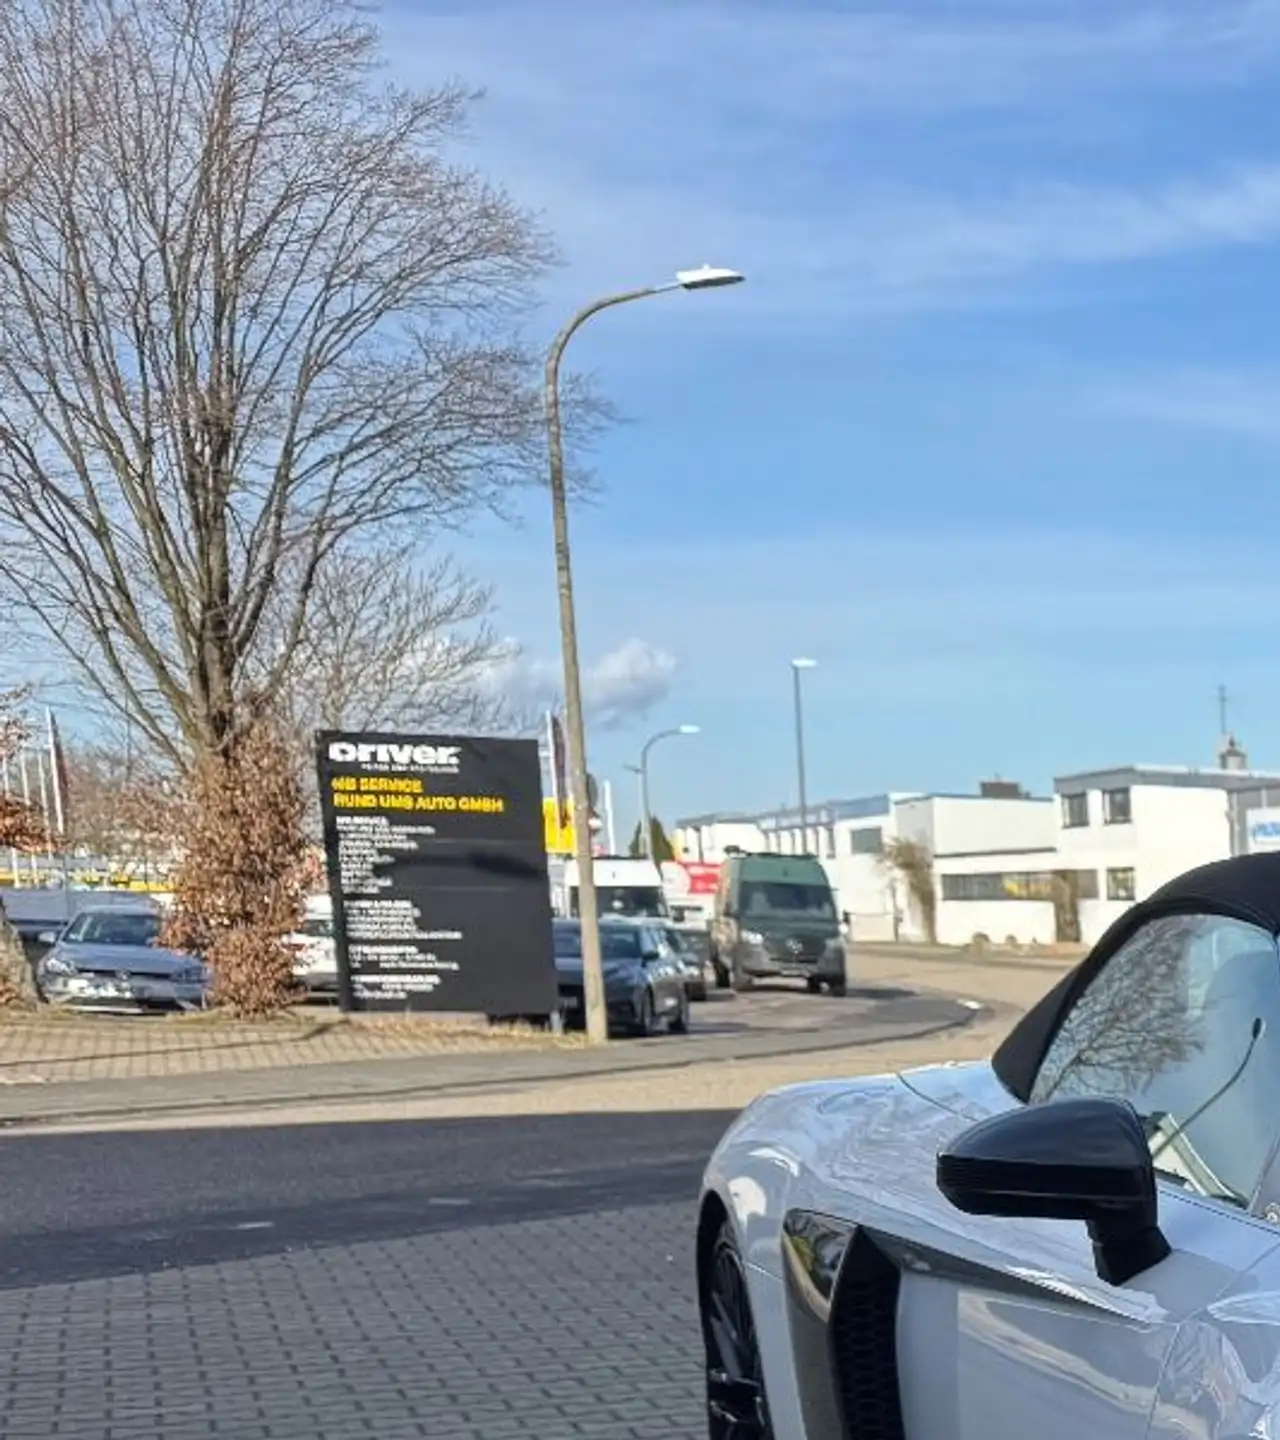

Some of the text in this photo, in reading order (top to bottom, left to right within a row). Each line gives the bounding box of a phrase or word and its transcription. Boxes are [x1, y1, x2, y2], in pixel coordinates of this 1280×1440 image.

[359, 777, 423, 794] SERVICE
[333, 792, 376, 809] RUND
[415, 796, 457, 811] AUTO
[458, 797, 504, 813] GMBH
